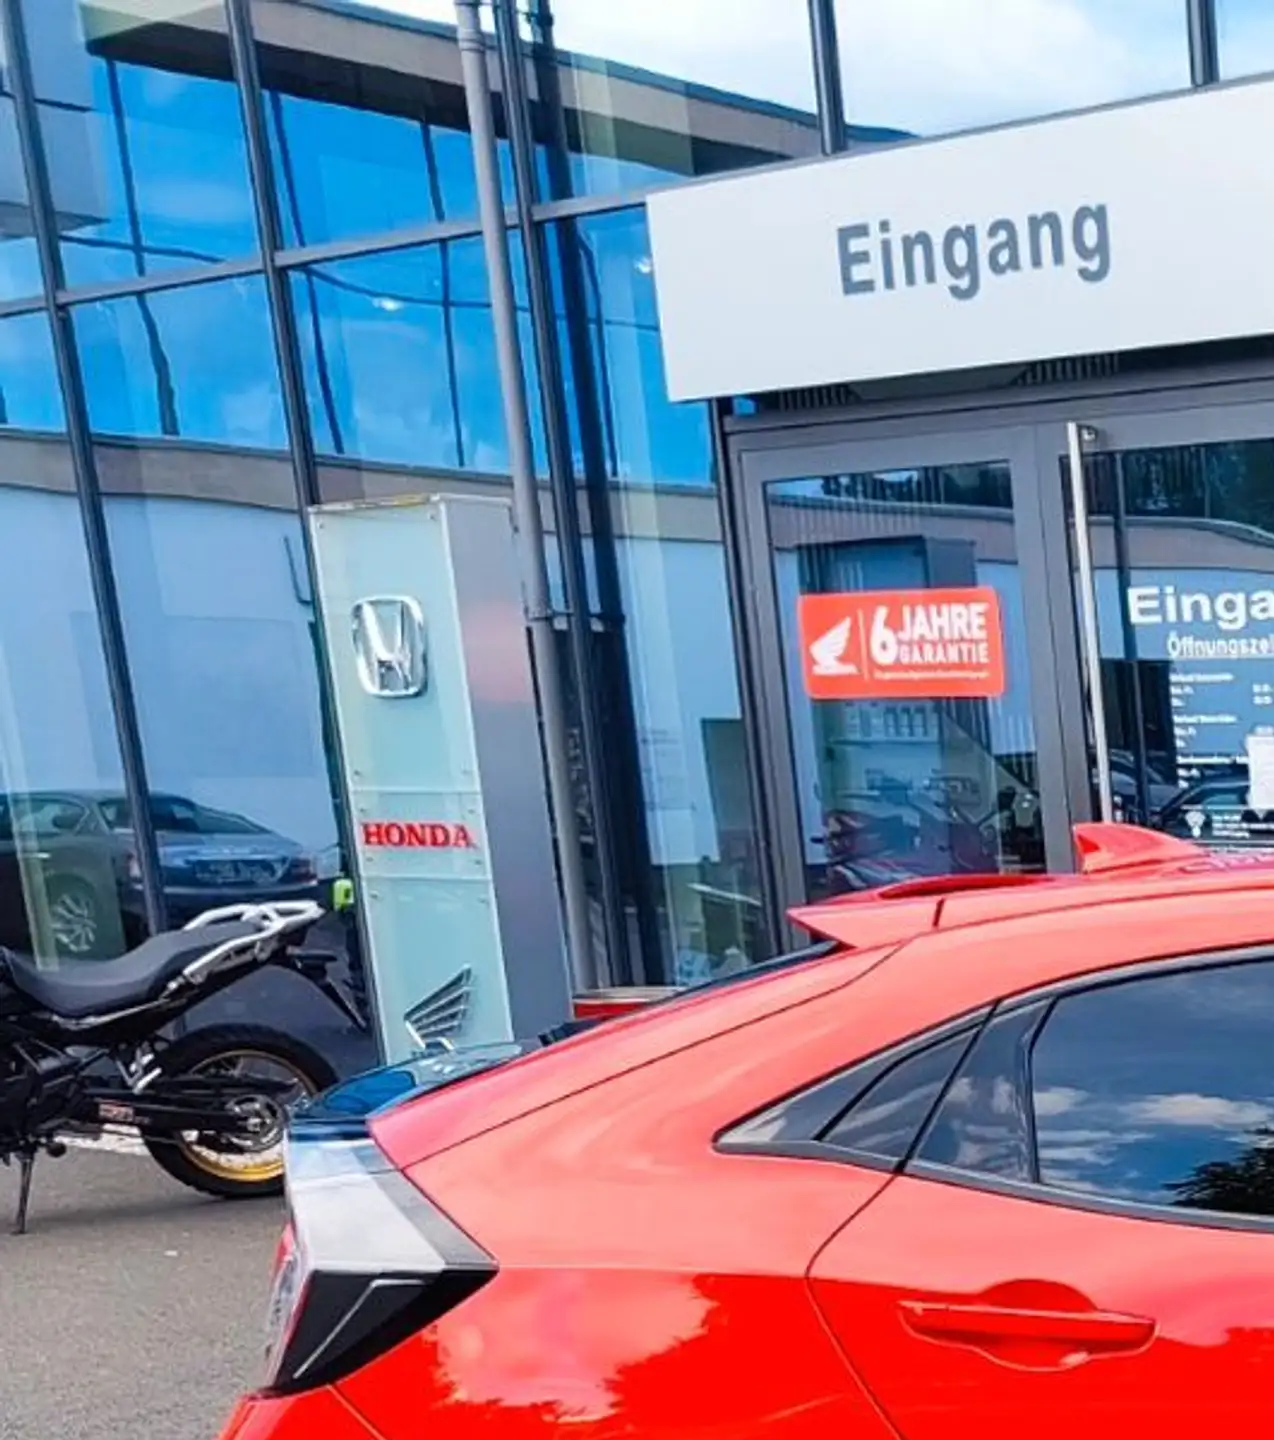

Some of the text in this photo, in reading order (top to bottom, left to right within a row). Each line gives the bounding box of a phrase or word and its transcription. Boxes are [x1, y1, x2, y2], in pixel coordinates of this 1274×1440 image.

[837, 204, 1111, 300] Eingang
[870, 603, 991, 665] 6 JAHRE
[899, 643, 990, 664] GARANTIE
[362, 822, 477, 848] HONDA
